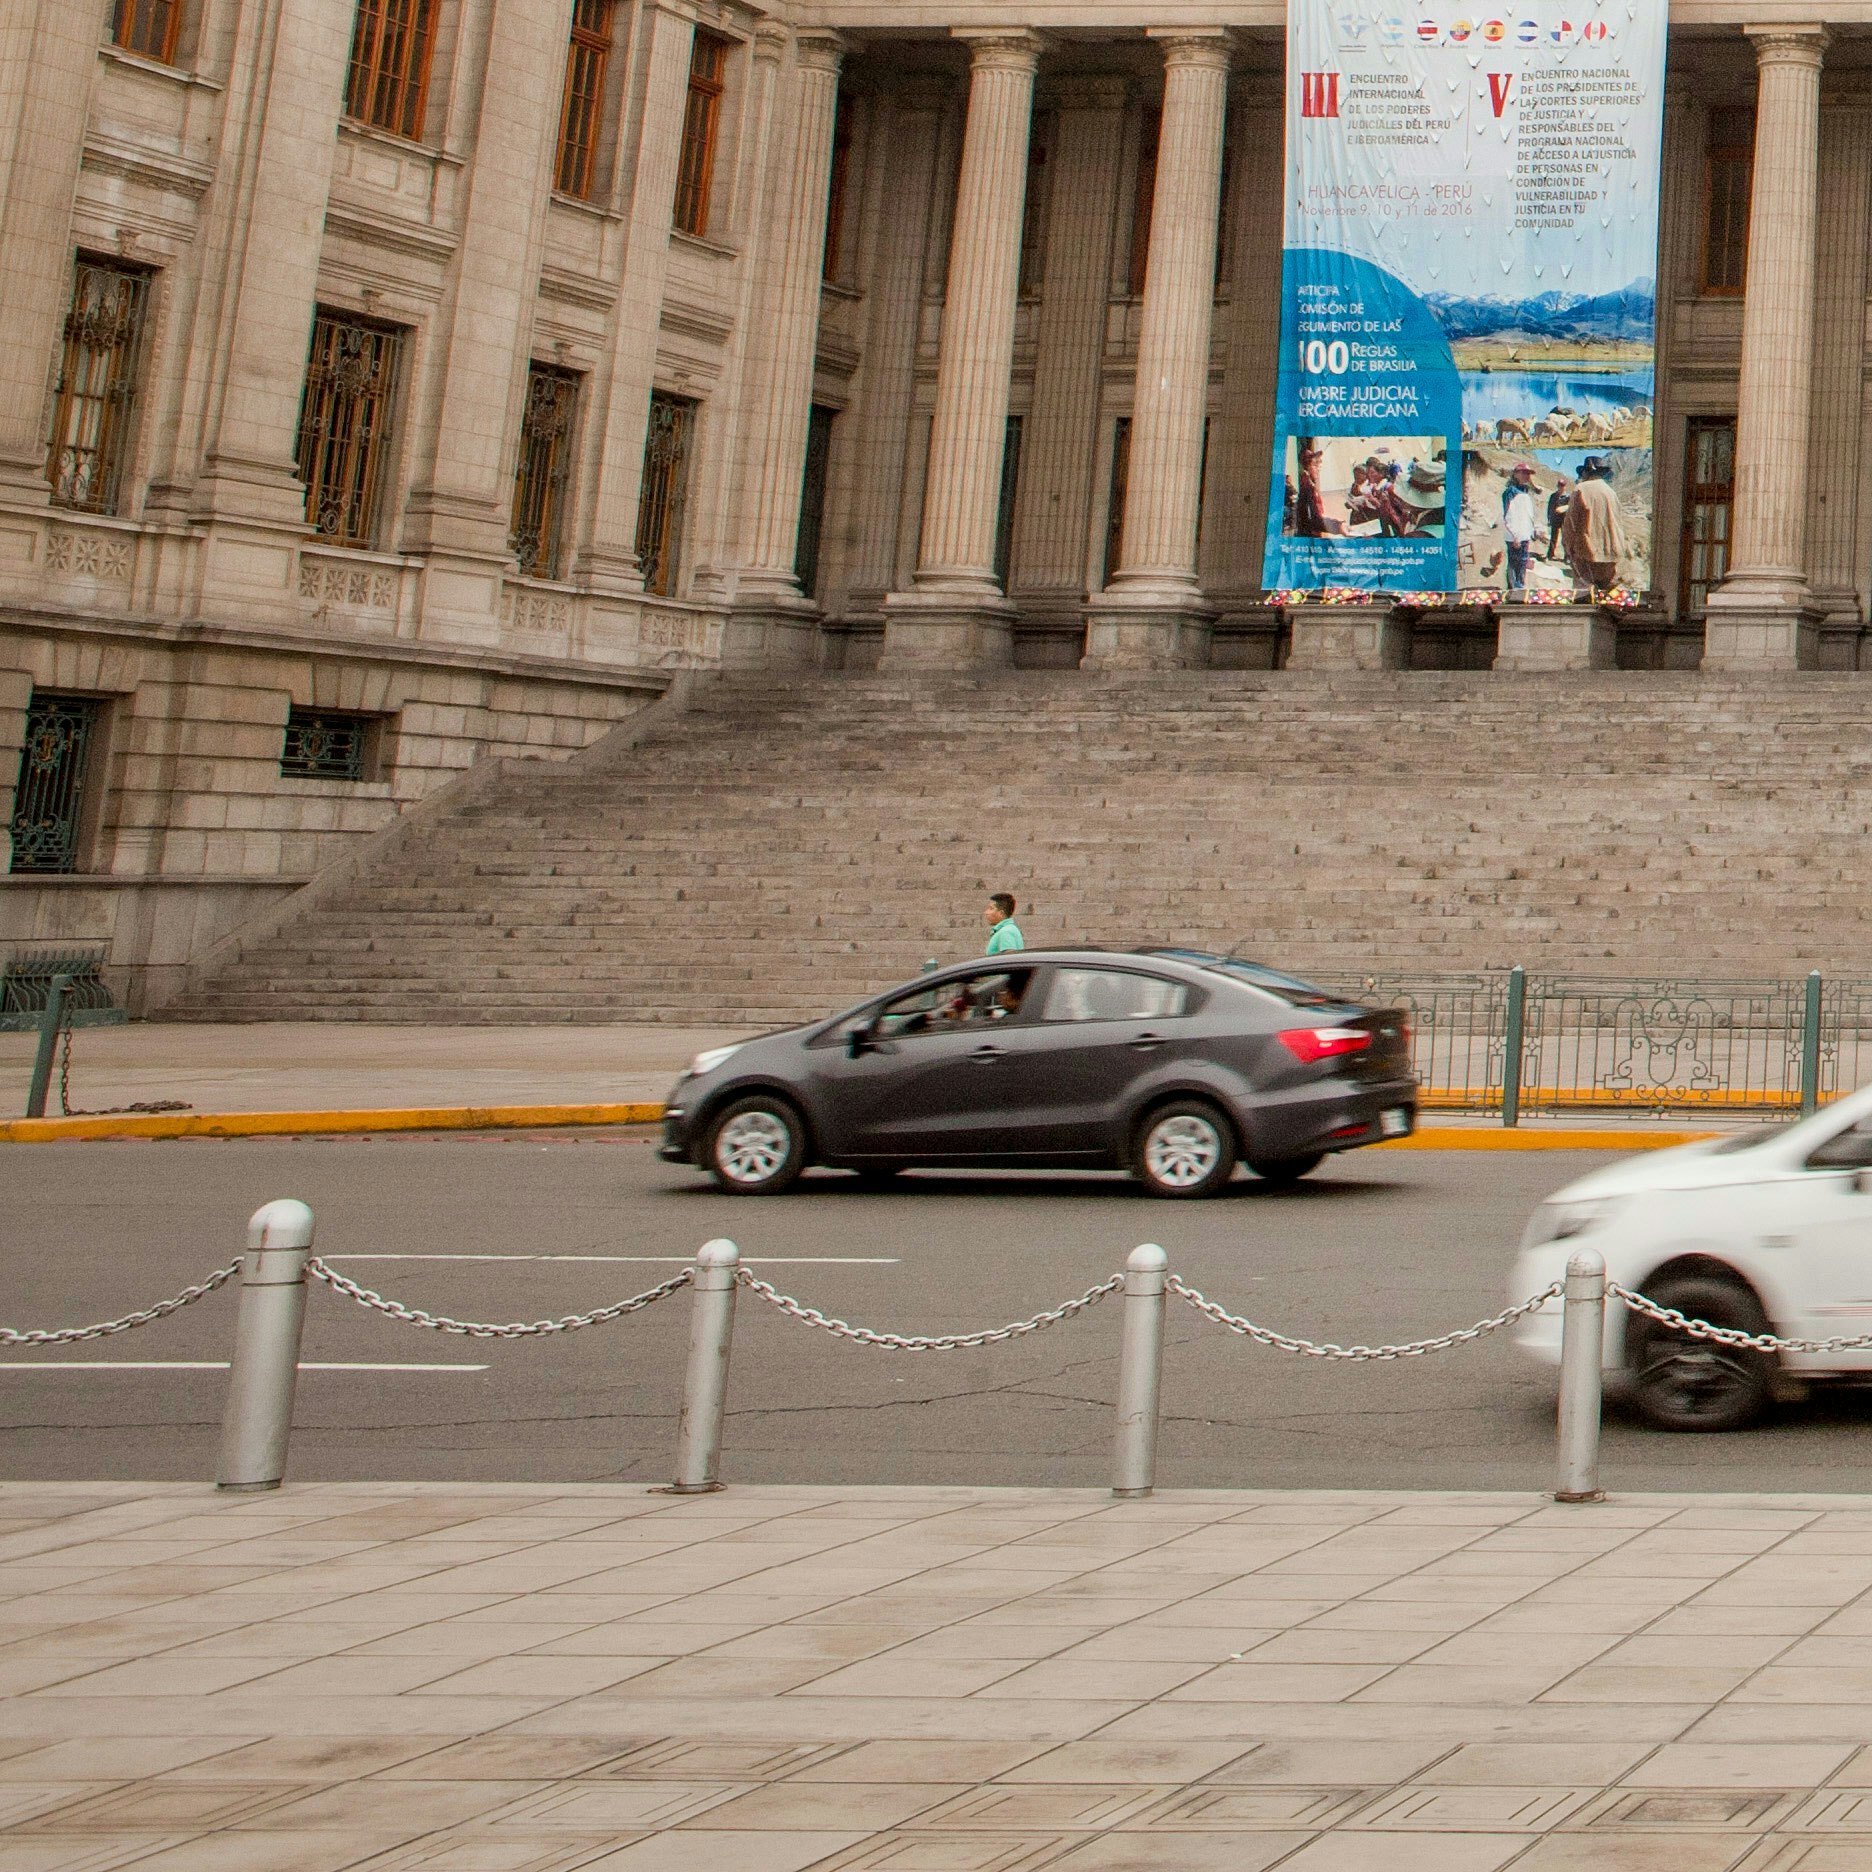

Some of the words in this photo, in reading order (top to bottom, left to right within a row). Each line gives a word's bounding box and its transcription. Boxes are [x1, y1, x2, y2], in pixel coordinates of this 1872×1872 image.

[1350, 74, 1408, 84] ENCUENTRO
[1521, 69, 1579, 82] ENCUENTRO
[1581, 69, 1630, 79] NACIONAL
[1349, 89, 1425, 99] INTERNACIONAL
[1521, 85, 1533, 95] DE
[1536, 83, 1554, 93] LOS
[1624, 82, 1637, 92] DE
[1301, 72, 1340, 117] III
[1487, 73, 1513, 117] V
[1540, 96, 1577, 106] CORTES
[1580, 95, 1641, 105] SUPERIORES
[1349, 104, 1361, 114] DE
[1365, 104, 1384, 114] LOS
[1386, 104, 1431, 114] PODERES
[1519, 111, 1532, 121] DE
[1533, 109, 1577, 120] JUSTICIA
[1578, 110, 1585, 118] Y
[1348, 119, 1403, 130] JUDICIALES
[1405, 119, 1423, 129] DEL
[1518, 123, 1594, 134] RESPONSABLES
[1596, 123, 1615, 132] DEL
[1348, 135, 1353, 144] E
[1518, 137, 1572, 147] PROGRAMA
[1575, 136, 1624, 146] NACIONAL
[1517, 151, 1530, 160] DE
[1532, 150, 1571, 159] ACCESO
[1572, 150, 1579, 159] A
[1581, 150, 1593, 159] LA
[1595, 149, 1637, 159] JUSTICIA
[1517, 164, 1529, 174] DE
[1532, 164, 1583, 173] PERSONAS
[1585, 164, 1599, 173] EN
[1572, 177, 1586, 186] DE
[1308, 184, 1420, 200] HUANCAVELICA
[1515, 191, 1598, 201] VULNERABILIDAD
[1602, 191, 1608, 200] Y
[1377, 204, 1392, 216] 10
[1395, 208, 1401, 220] y
[1407, 204, 1419, 216] 11
[1423, 203, 1437, 216] de
[1441, 203, 1473, 216] 2016
[1514, 204, 1556, 215] JUSTICIA
[1559, 204, 1572, 214] EN
[1514, 218, 1574, 228] COMUNIDAD
[1349, 303, 1364, 314] DE
[1363, 321, 1380, 332] DE
[1383, 319, 1402, 332] LAS
[1351, 360, 1366, 371] DE
[1369, 359, 1417, 371] BRASILIA
[1352, 385, 1419, 401] JUDICIAL
